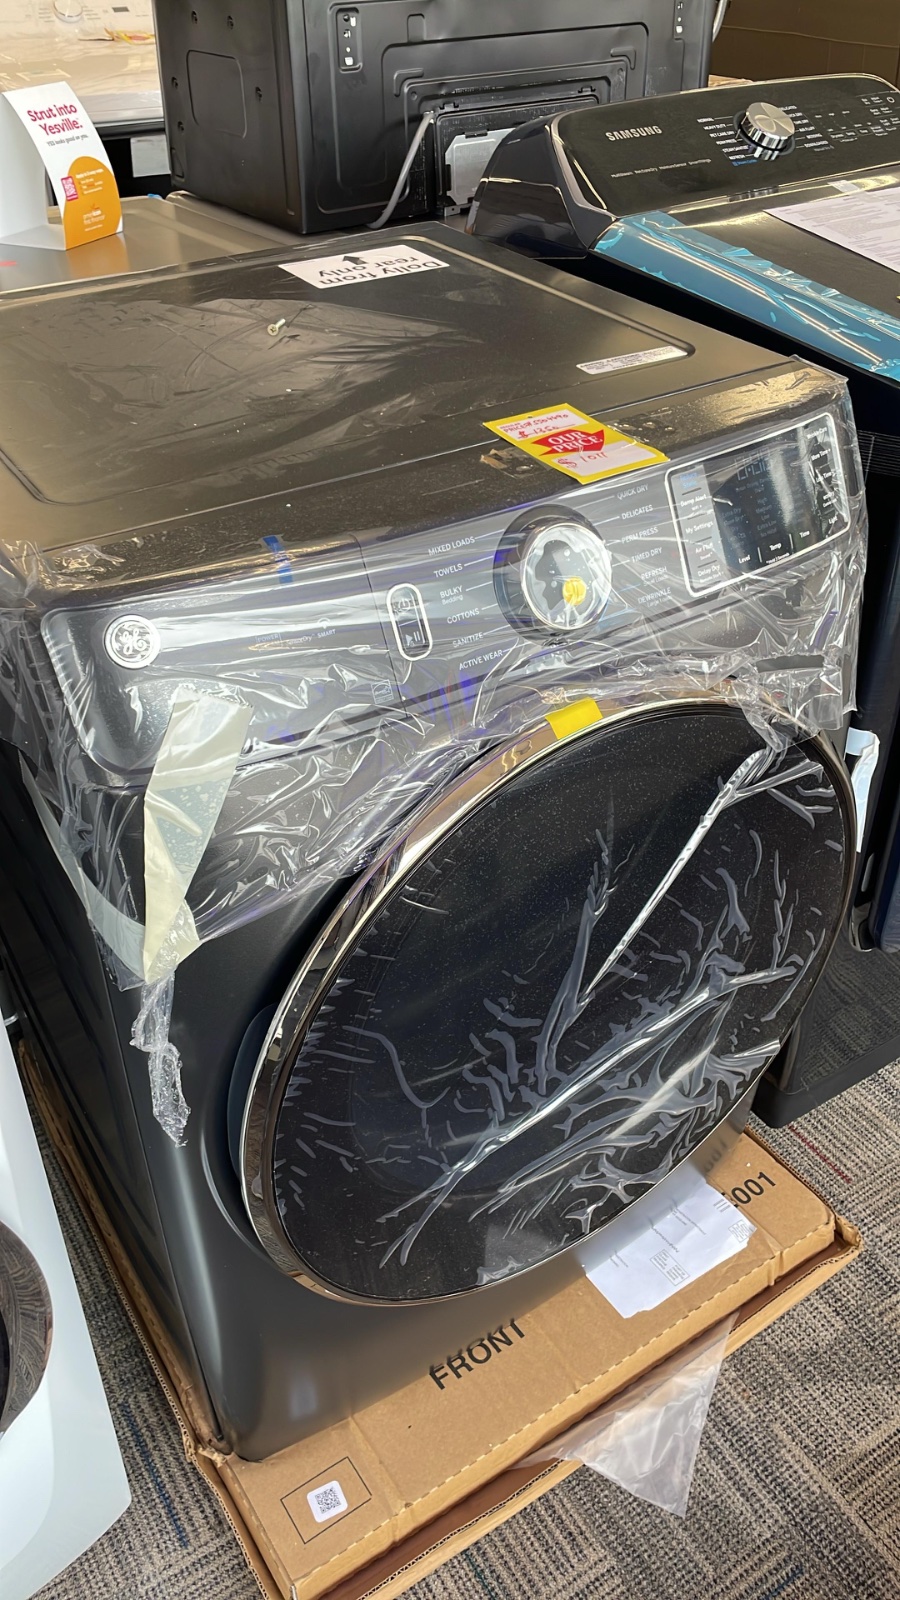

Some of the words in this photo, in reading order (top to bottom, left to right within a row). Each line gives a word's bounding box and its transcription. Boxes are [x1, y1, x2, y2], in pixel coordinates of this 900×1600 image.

[27, 105, 57, 122] Strut
[55, 102, 78, 117] into
[605, 125, 663, 141] SAMSUNG
[374, 256, 419, 268] rear
[382, 261, 441, 275] Dolly
[319, 264, 367, 278] only
[319, 271, 378, 285] from
[548, 430, 588, 445] OUR
[552, 434, 603, 453] PRICE
[616, 487, 636, 500] QUICK
[636, 483, 650, 495] DRY
[621, 504, 654, 520] DELICATES
[639, 526, 659, 539] PRESS
[428, 543, 451, 556] MIXED
[451, 535, 476, 549] LOADS
[631, 550, 650, 564] TIMED
[650, 546, 663, 557] DRY
[738, 554, 751, 564] Level
[433, 563, 463, 578] TOWELS
[640, 565, 668, 581] REFRESH
[439, 585, 463, 599] BULKY
[447, 607, 480, 624] COTTONS
[317, 628, 336, 639] SMART
[452, 631, 484, 648] SANITIZE
[458, 656, 484, 670] ACTIVE
[483, 649, 504, 664] WEAR
[428, 1318, 526, 1391] FRONT
